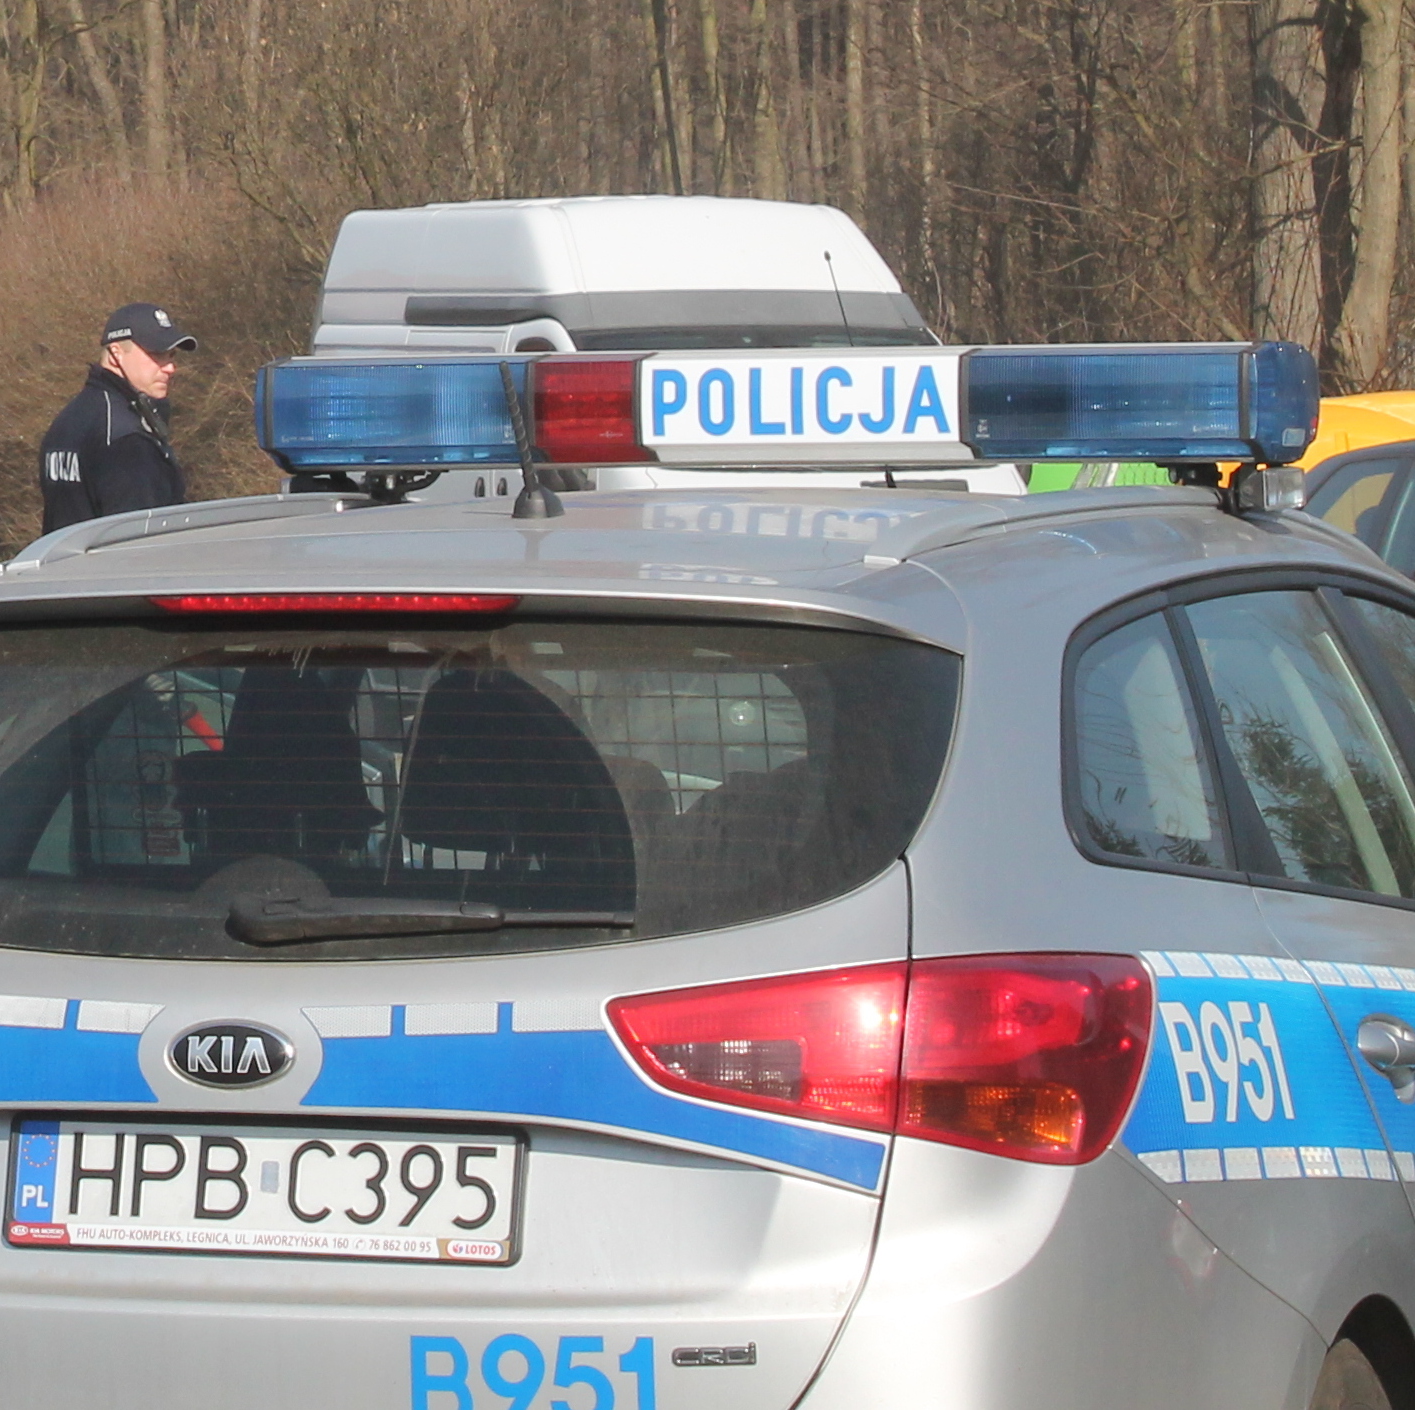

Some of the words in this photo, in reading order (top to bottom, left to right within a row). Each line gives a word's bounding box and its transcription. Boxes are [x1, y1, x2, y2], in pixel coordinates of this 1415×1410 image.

[652, 365, 951, 436] POLICJA
[187, 1035, 272, 1073] KIA
[1158, 1000, 1296, 1123] B951
[21, 1185, 49, 1208] PL
[68, 1132, 250, 1220] HPB
[288, 1140, 498, 1230] C395
[77, 1229, 95, 1239] FHU
[187, 1231, 232, 1245] LEGNICA,
[252, 1233, 329, 1248] JAWORZYŃSKA
[333, 1237, 349, 1249] 160
[369, 1238, 380, 1250] 76
[383, 1239, 401, 1251] 862
[404, 1240, 416, 1252] 00
[419, 1240, 432, 1252] 95
[465, 1244, 497, 1255] LOTOS
[410, 1333, 656, 1410] B951
